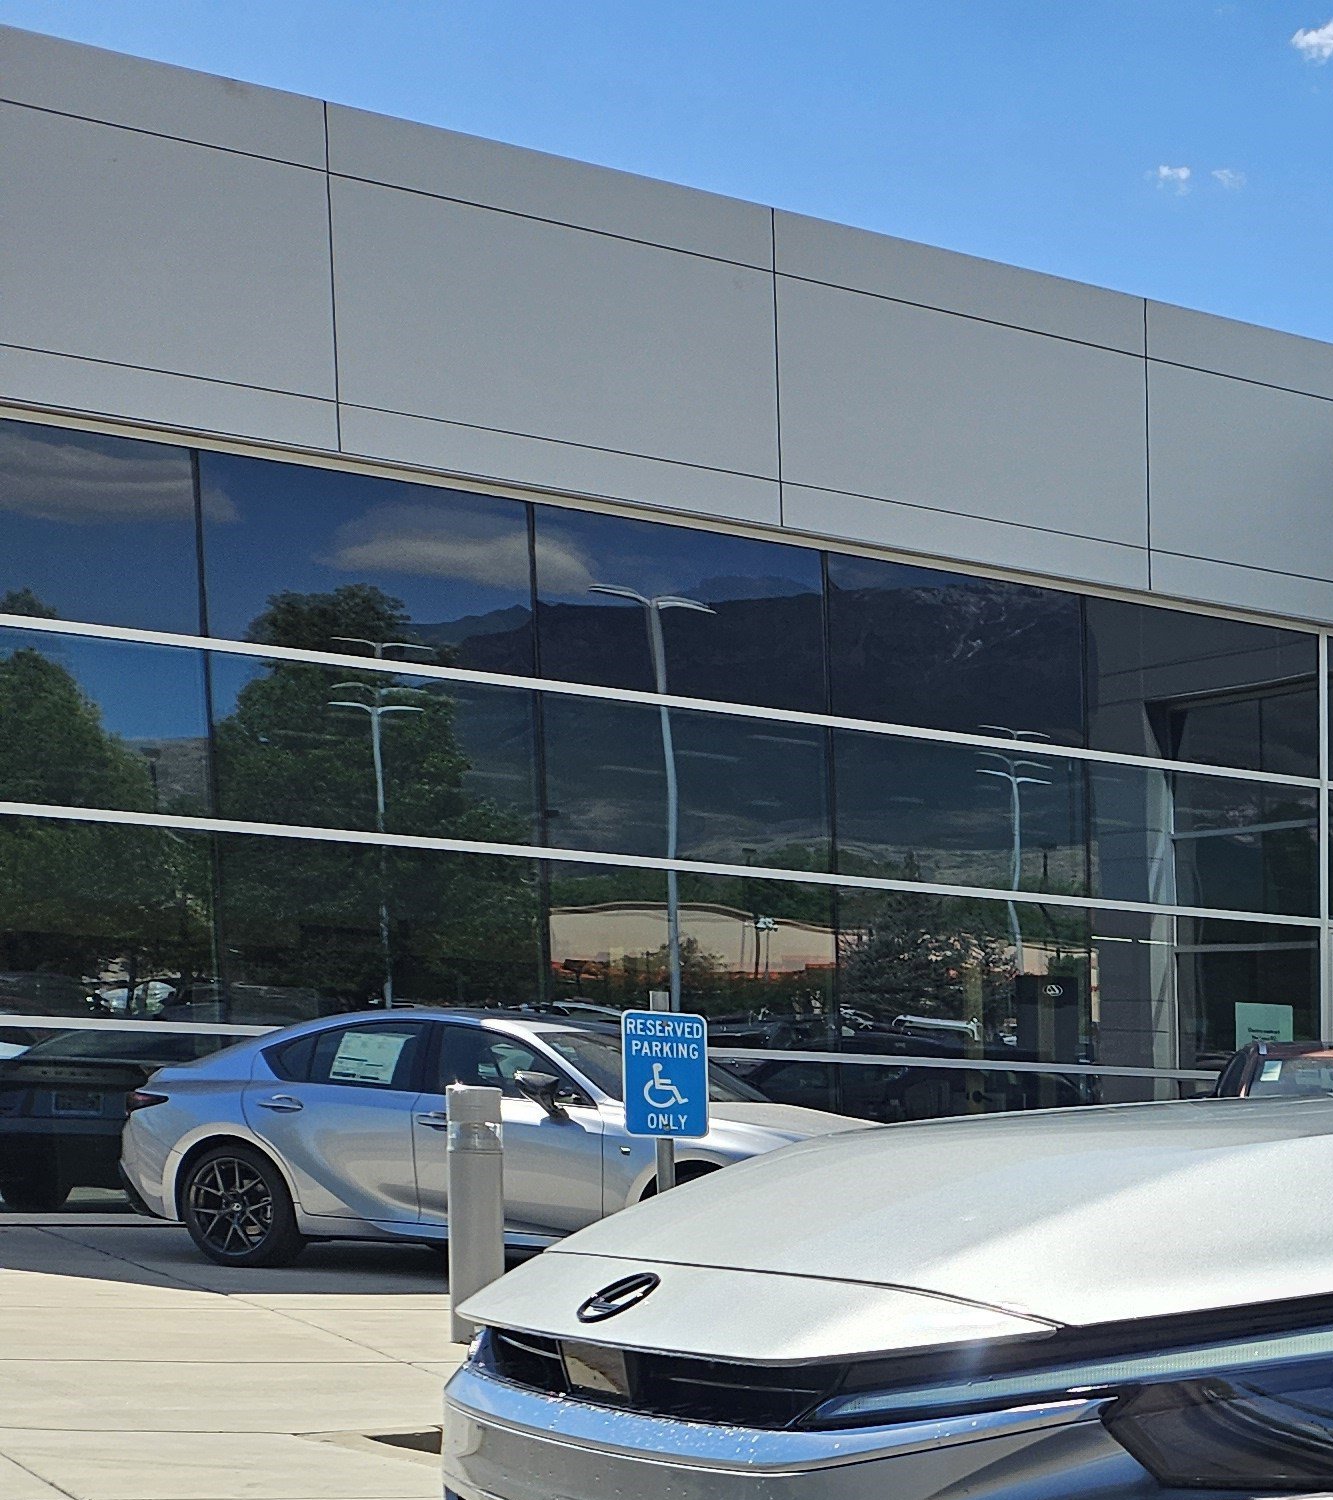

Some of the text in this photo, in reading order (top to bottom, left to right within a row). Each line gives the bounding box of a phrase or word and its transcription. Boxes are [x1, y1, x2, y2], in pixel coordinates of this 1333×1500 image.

[626, 1018, 703, 1039] RESERVED
[631, 1040, 699, 1060] PARKING
[647, 1112, 688, 1131] ONLY
